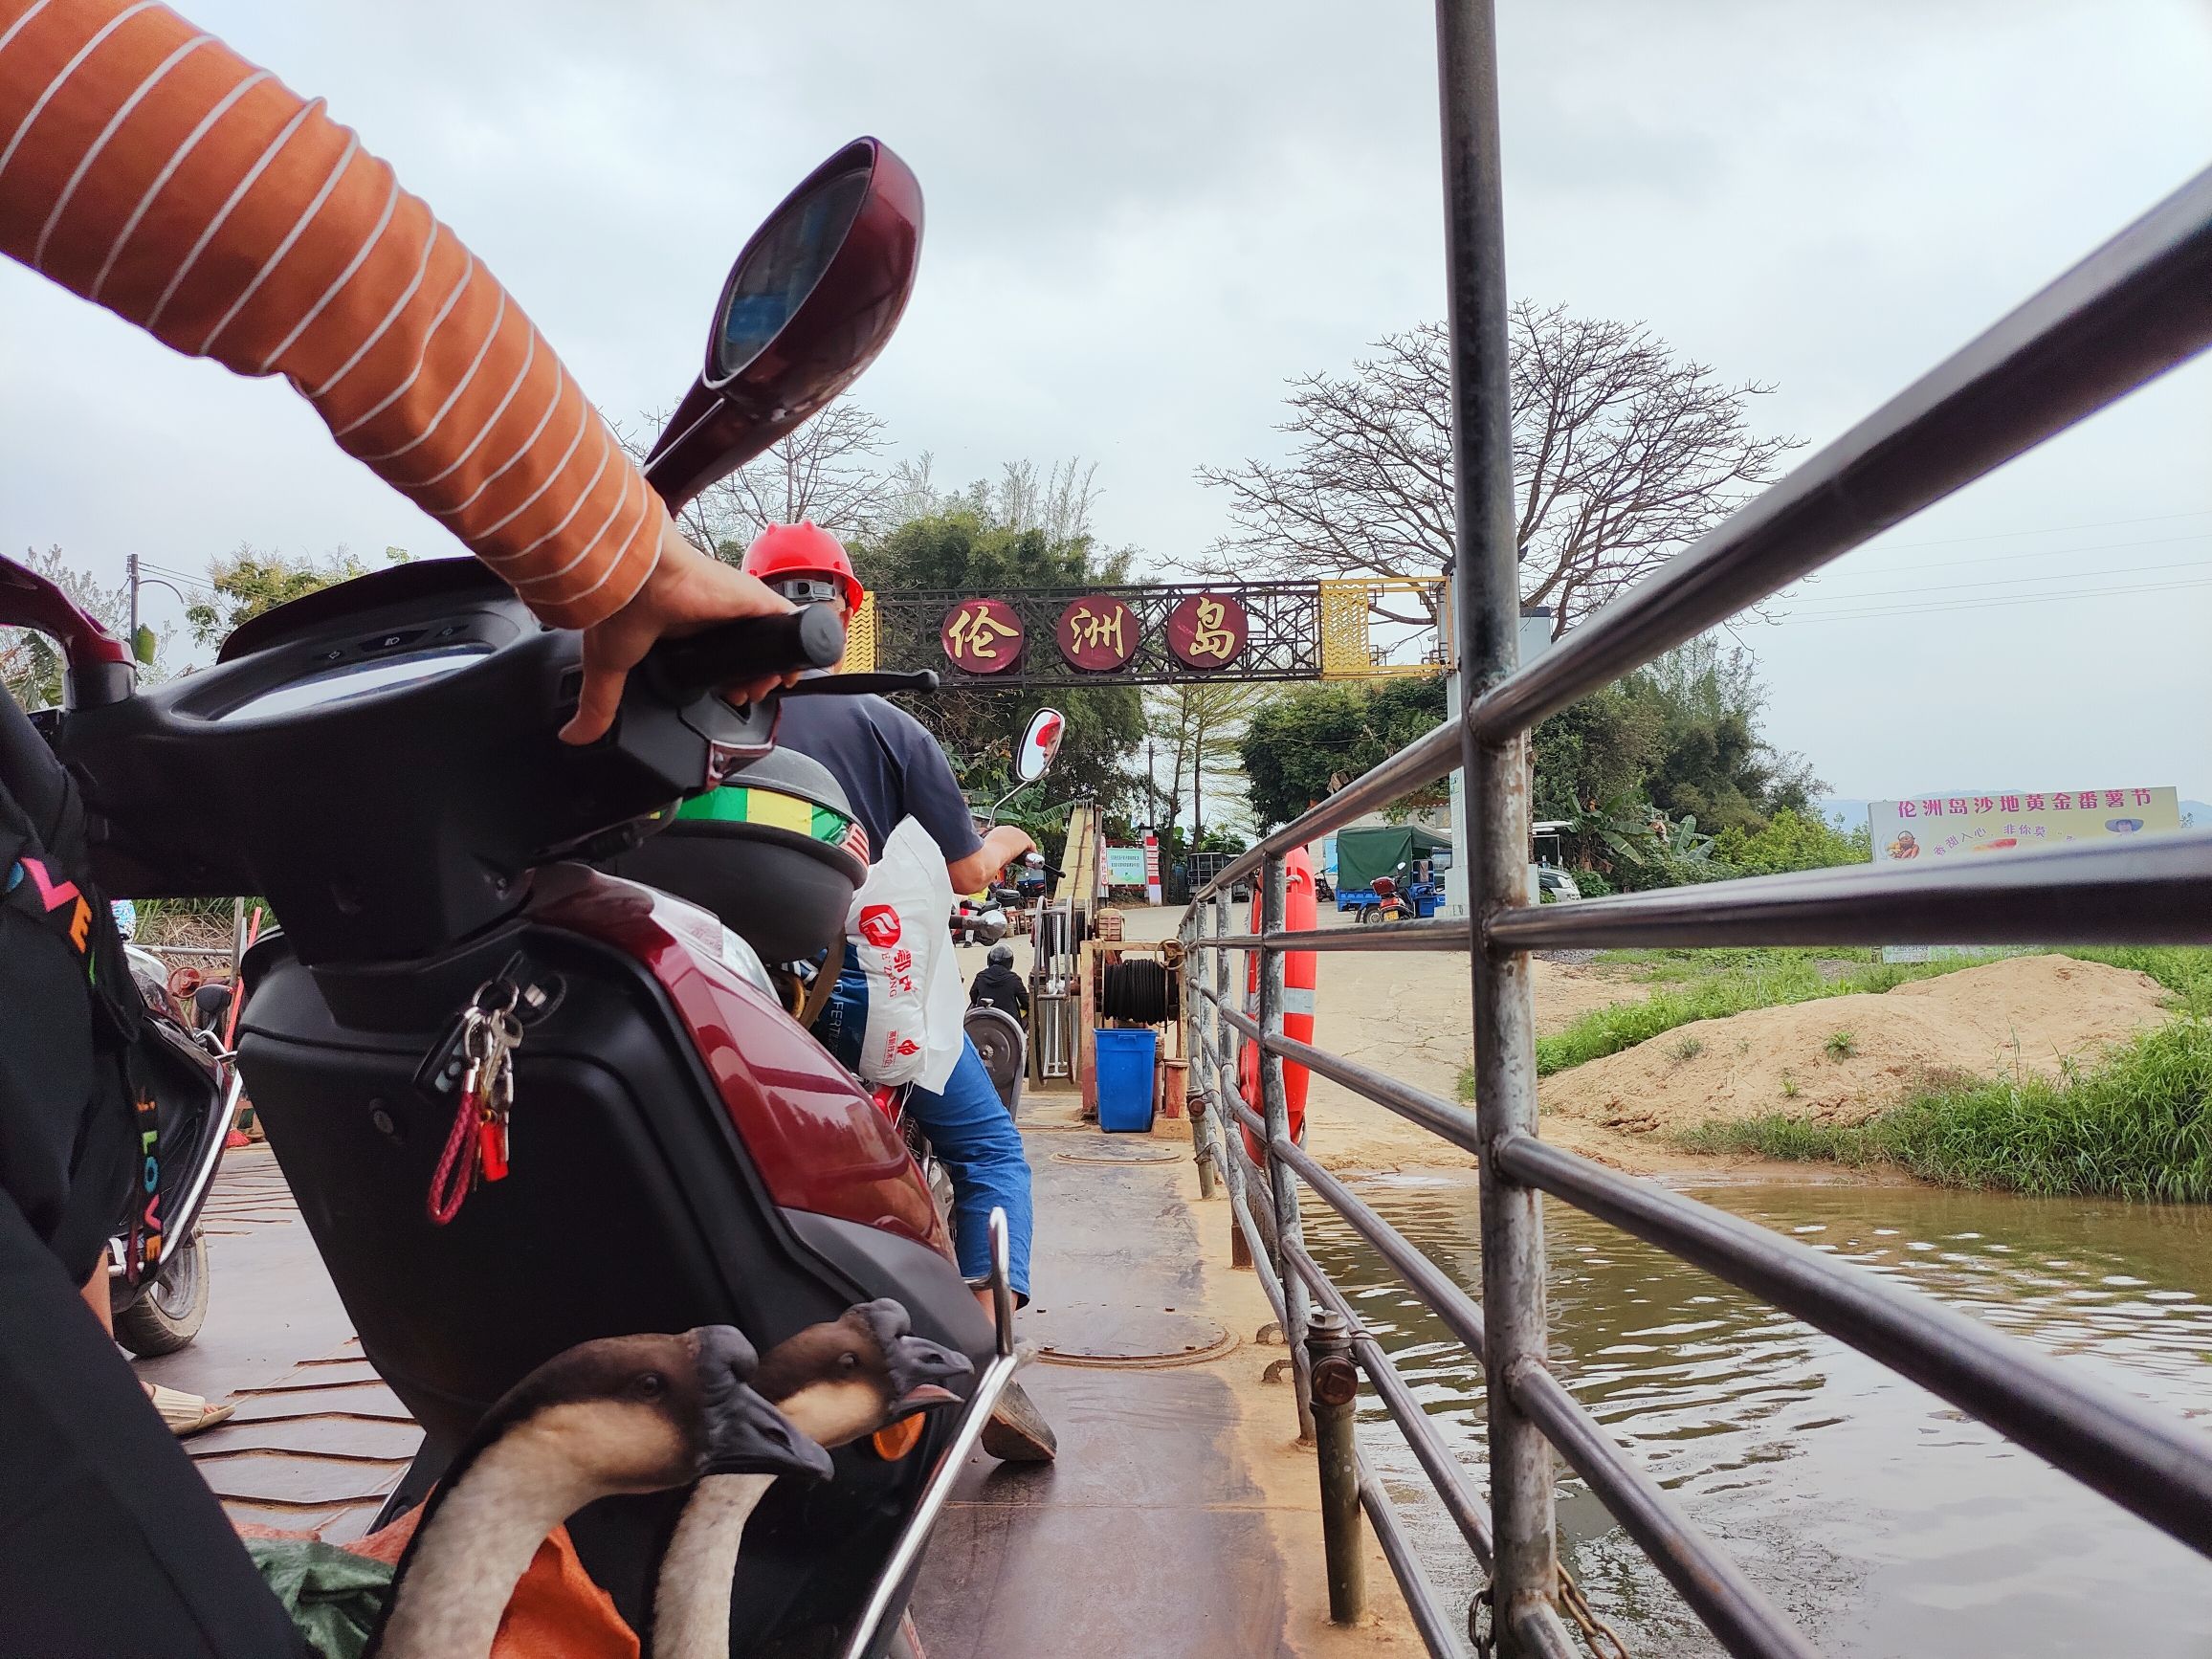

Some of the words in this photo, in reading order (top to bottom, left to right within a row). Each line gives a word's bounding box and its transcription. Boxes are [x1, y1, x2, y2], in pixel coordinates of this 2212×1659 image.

[948, 597, 1236, 660] 伦洲岛
[1898, 787, 2152, 819] 伦洲岛沙地黄金番薯节
